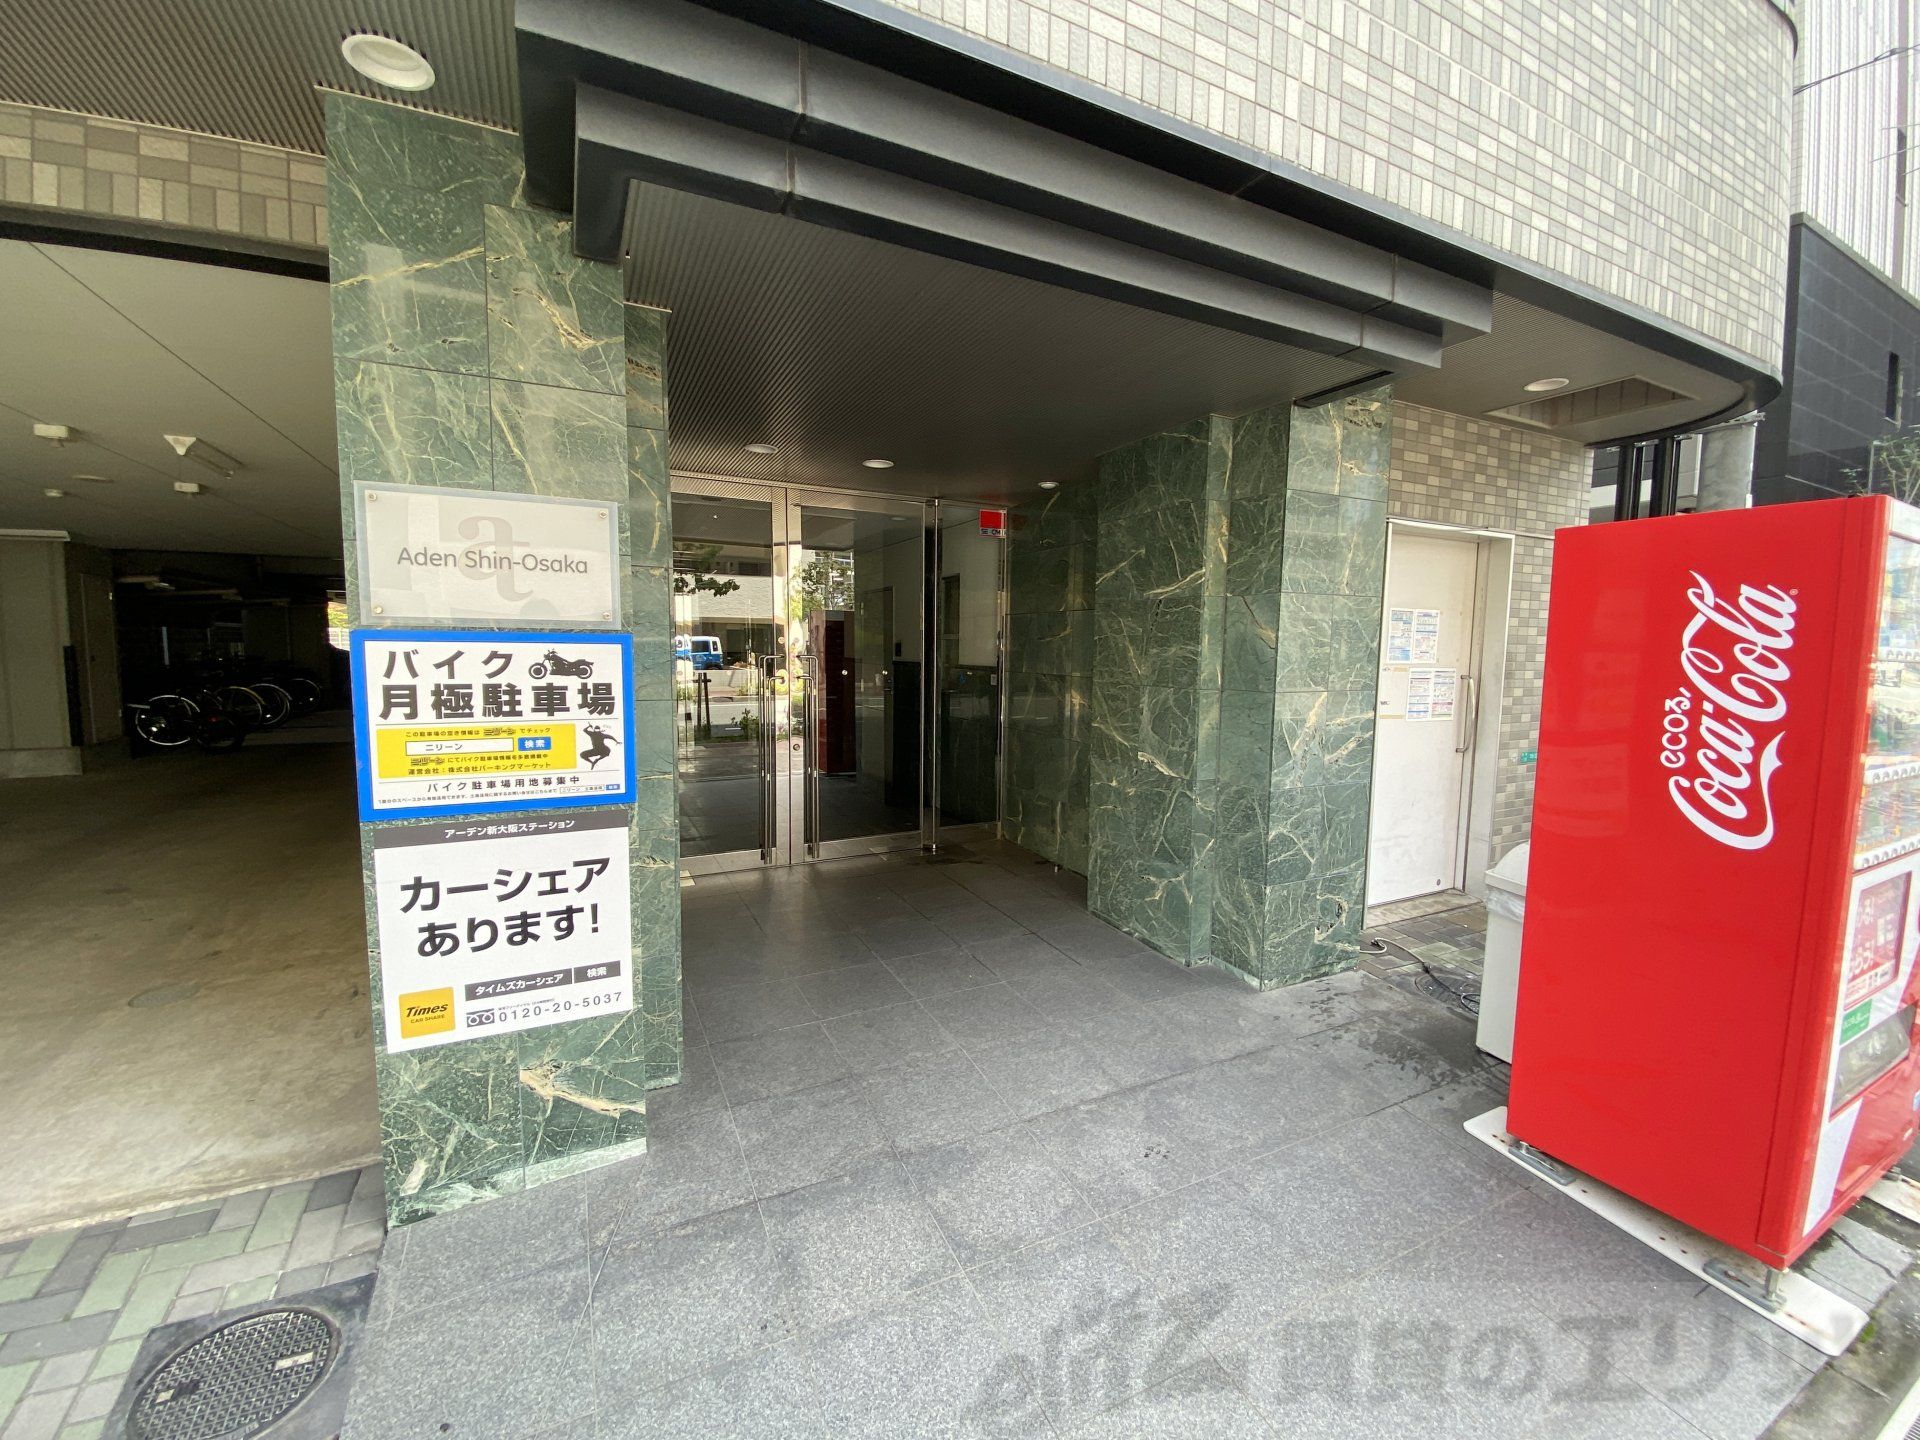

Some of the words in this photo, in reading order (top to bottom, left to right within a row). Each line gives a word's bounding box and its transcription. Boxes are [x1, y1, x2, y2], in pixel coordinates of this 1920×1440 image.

[397, 546, 458, 568] Aden
[464, 550, 588, 574] Shin-Osaka
[383, 650, 514, 680] バイク
[379, 682, 616, 720] 月極駐車場
[1668, 569, 1799, 850] Coca-Cola
[425, 743, 463, 751] ニリーン
[524, 739, 546, 749] 検索
[427, 775, 581, 793] バイク駐車場用地募集中
[444, 819, 575, 839] アーデン新大阪ステーション
[399, 857, 611, 914] カーシェア
[416, 902, 599, 958] あります！
[475, 972, 565, 997] タイムズカーシェア
[586, 965, 608, 979] 検索
[406, 1003, 449, 1018] Times
[498, 991, 623, 1023] 0120-20-5037
